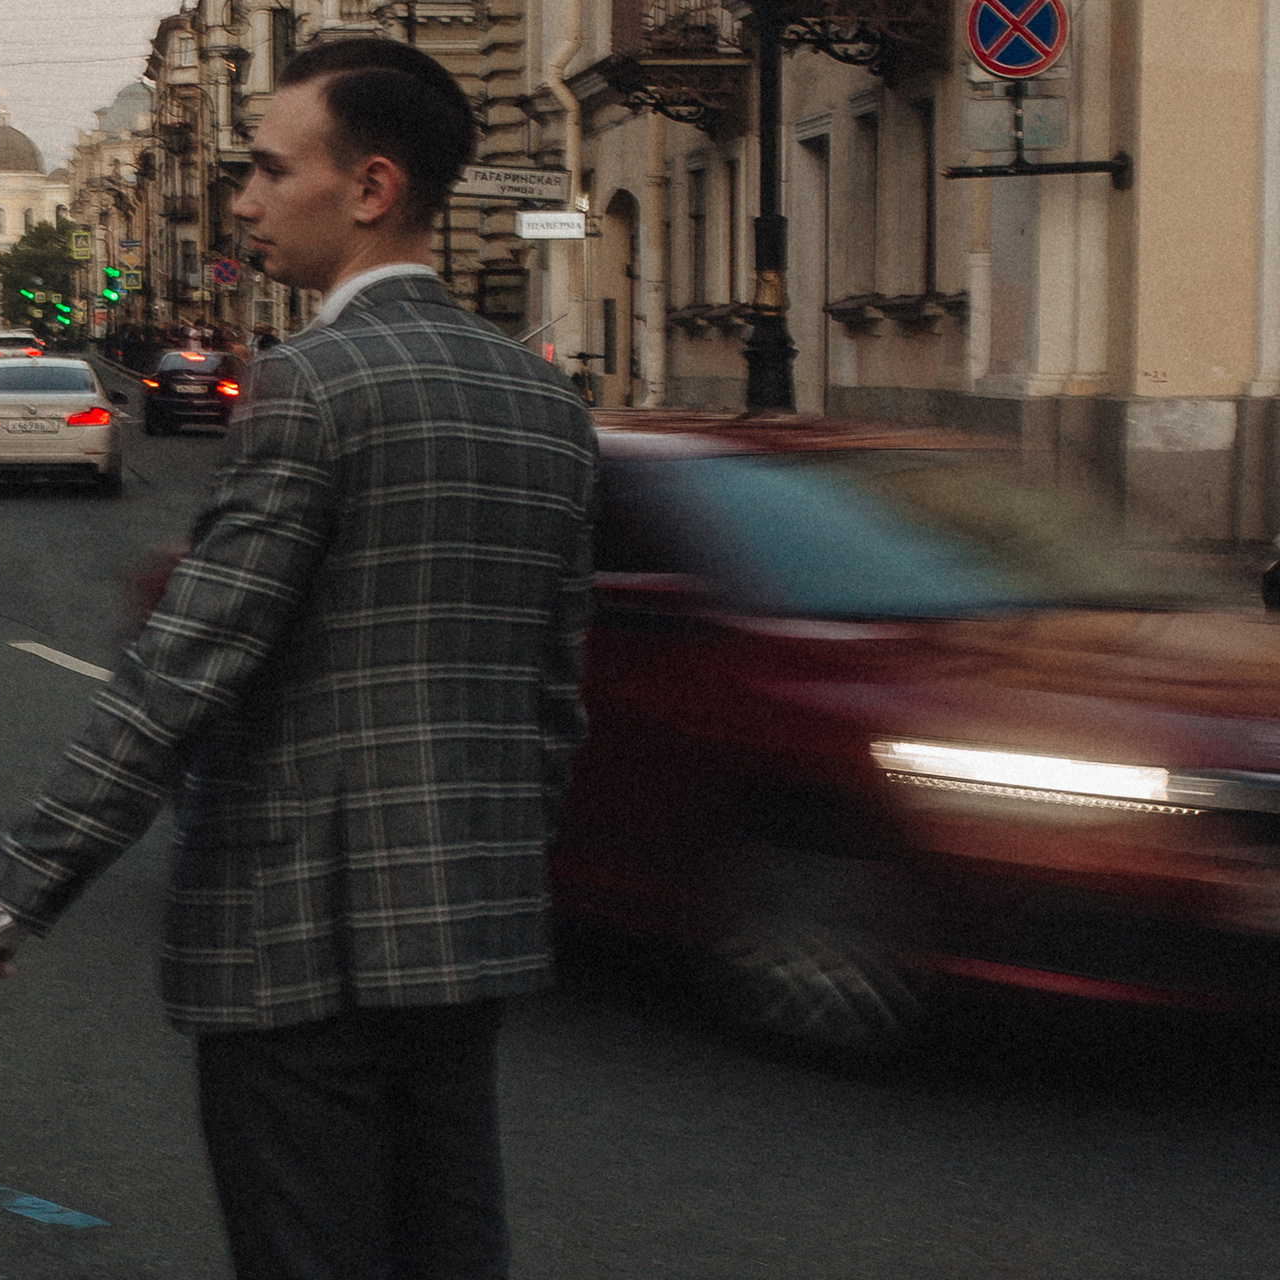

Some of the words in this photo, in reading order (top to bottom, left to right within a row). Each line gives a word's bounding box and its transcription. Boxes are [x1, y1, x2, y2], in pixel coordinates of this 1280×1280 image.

[474, 171, 561, 186] ГАГАРИНСКАЯ
[500, 185, 534, 195] улица
[526, 222, 582, 231] ШАВЕРМА
